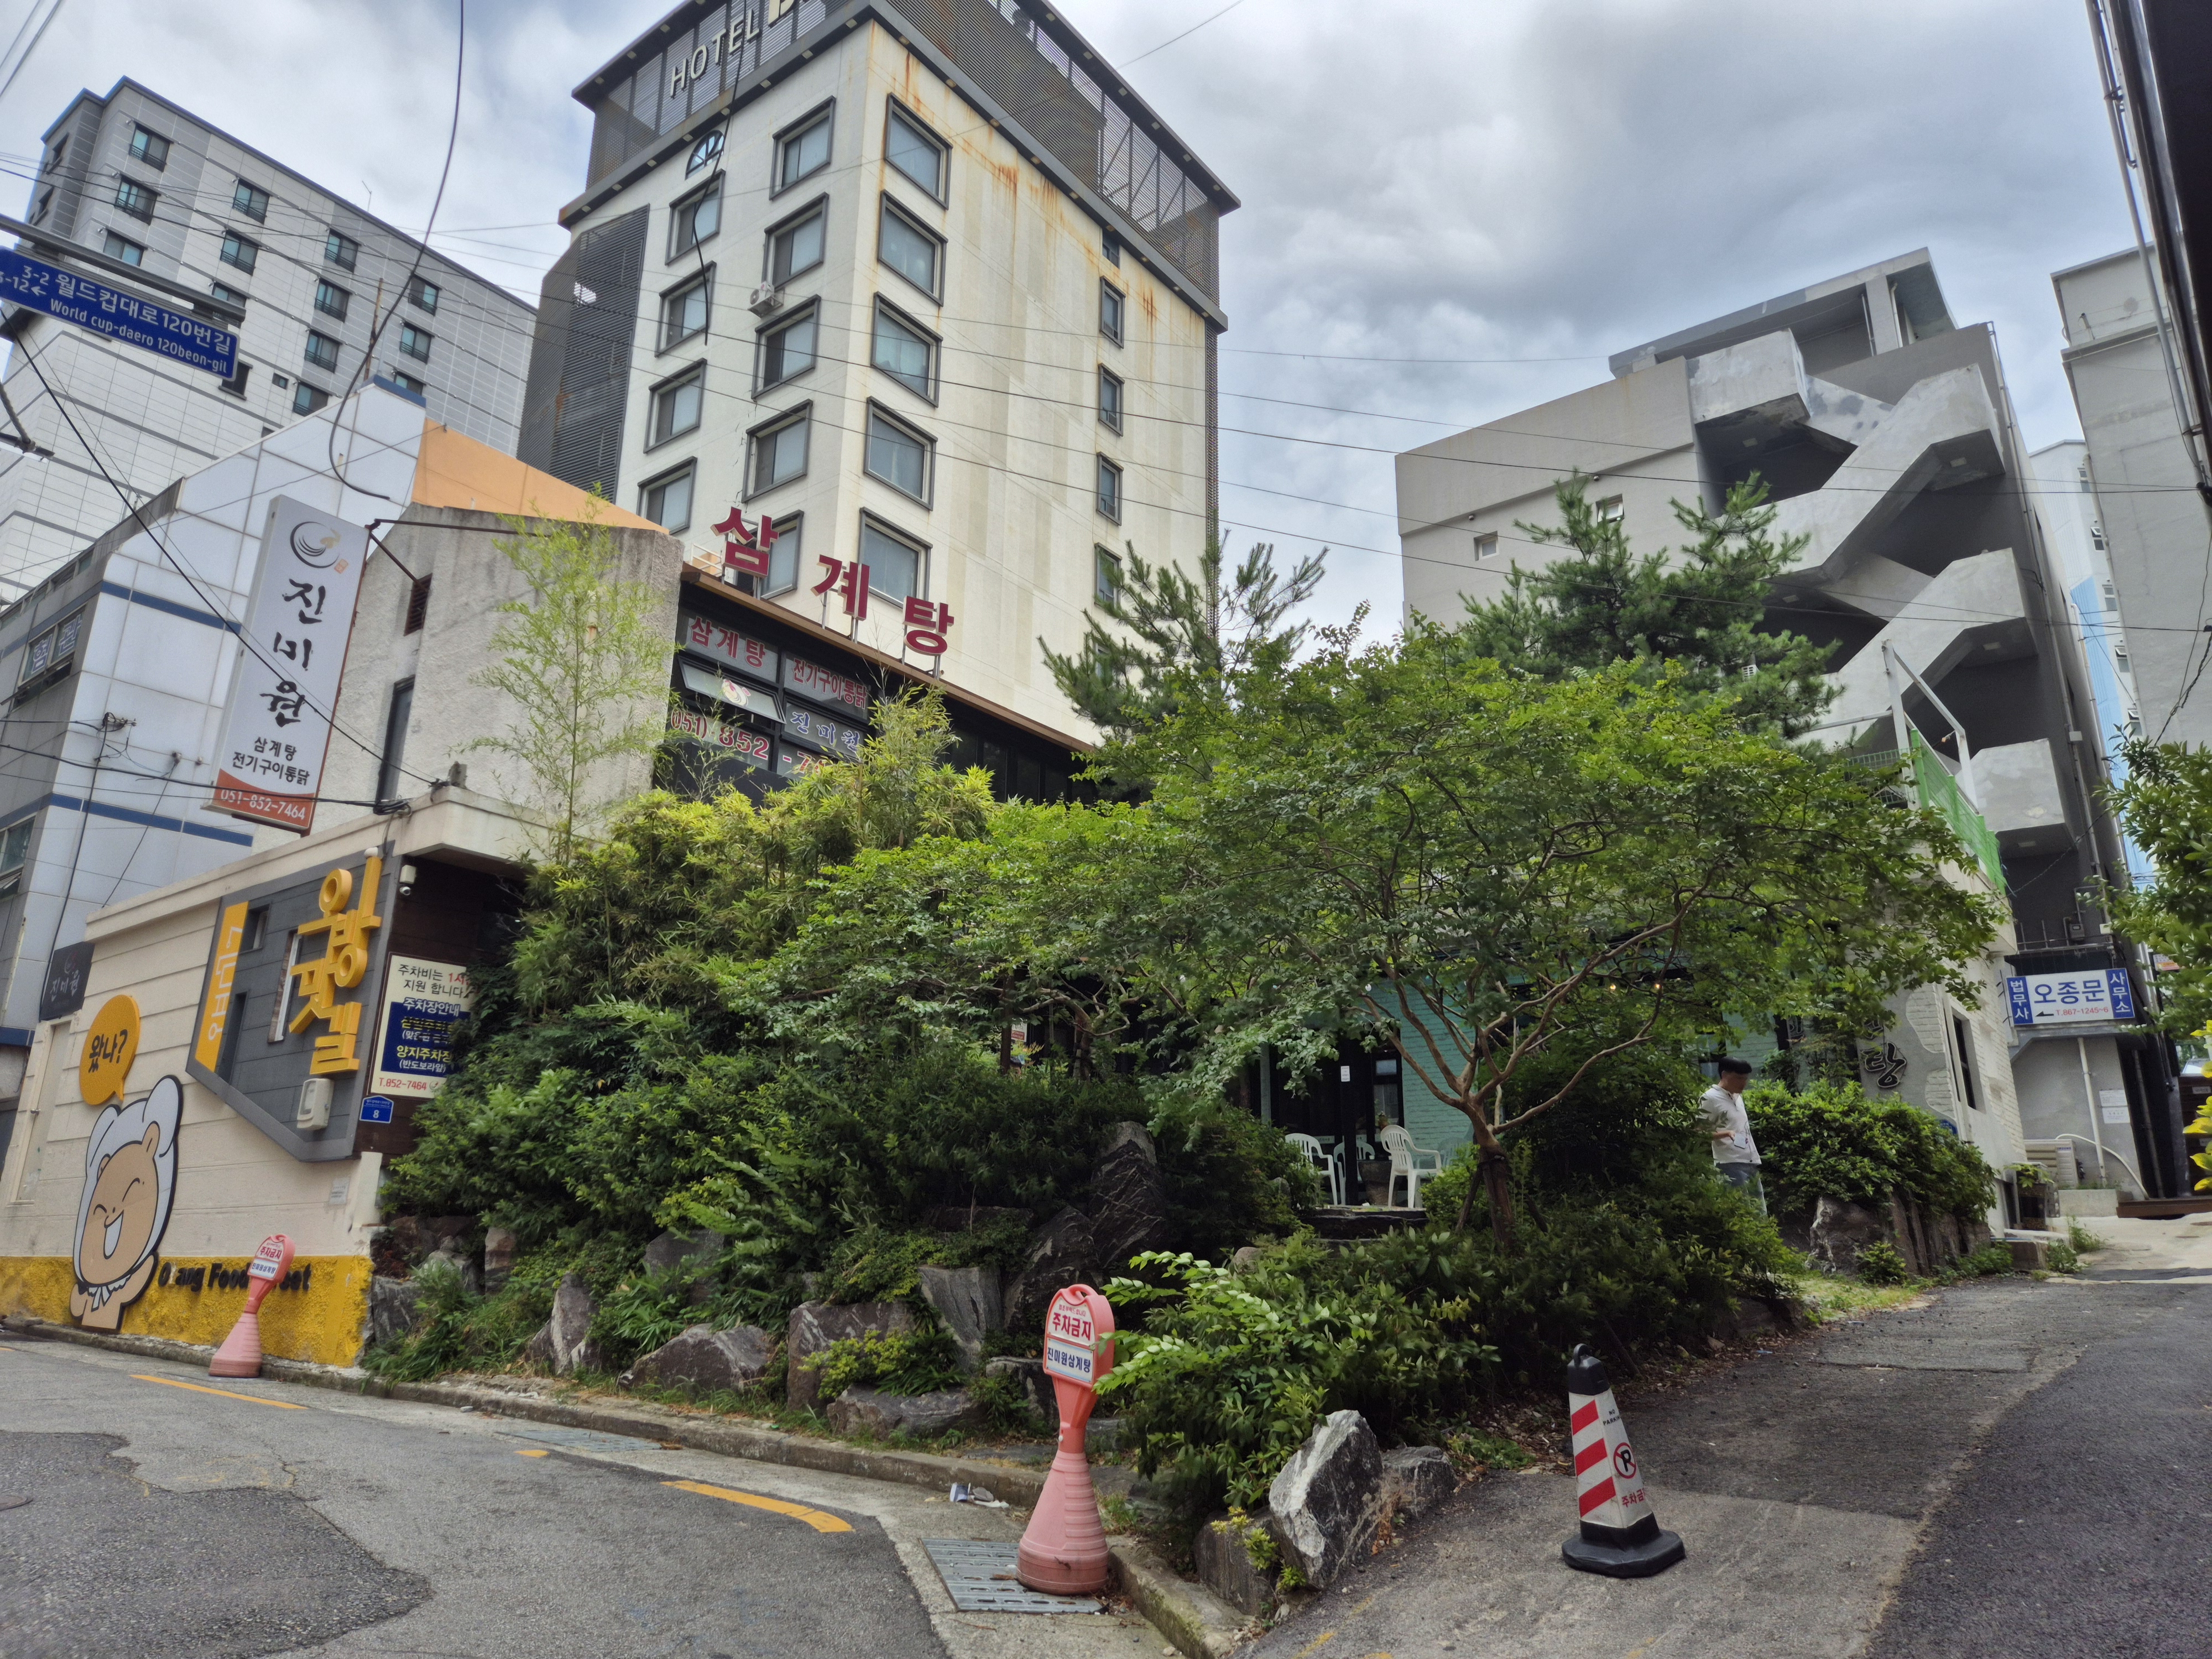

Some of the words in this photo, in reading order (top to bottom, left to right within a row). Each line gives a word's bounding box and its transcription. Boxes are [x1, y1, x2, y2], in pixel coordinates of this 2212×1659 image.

[670, 9, 760, 98] HOTEL
[22, 265, 50, 286] 3-2
[55, 274, 230, 356] 월드컵대로120번길
[51, 298, 87, 322] World
[91, 315, 154, 347] cup-daero
[158, 337, 227, 374] 120beon-gil
[710, 507, 954, 656] 삼계탕
[259, 578, 327, 728] 진미원
[690, 615, 766, 669] 삼계탕
[792, 658, 868, 710] 전기구이통닭
[790, 711, 860, 752] 진미원
[254, 736, 297, 761] 삼계탕
[232, 752, 310, 786] 전기구이통닭
[221, 788, 306, 821] 051-852-7464
[49, 969, 81, 1002] 진미원
[398, 964, 444, 982] 주차비는
[403, 979, 426, 992] 지원
[431, 982, 463, 998] 합니다
[2010, 979, 2030, 1020] 법무사
[2033, 979, 2105, 1004] 오종문
[2109, 972, 2131, 1013] 사무소
[403, 997, 461, 1017] 주차장안내
[2055, 1006, 2109, 1016] T.867-1245~6
[88, 1029, 128, 1073] 왔나?
[379, 1077, 427, 1091] T.852-7464
[373, 1109, 380, 1119] 8
[260, 1246, 283, 1260] 주차금지
[158, 1262, 205, 1292] Oang
[207, 1262, 251, 1289] Food
[1052, 1312, 1092, 1341] 주차금지
[1047, 1347, 1091, 1374] 진미원삼계탕
[1603, 1416, 1621, 1426] PARKIN
[1621, 1488, 1646, 1508] 주차금
